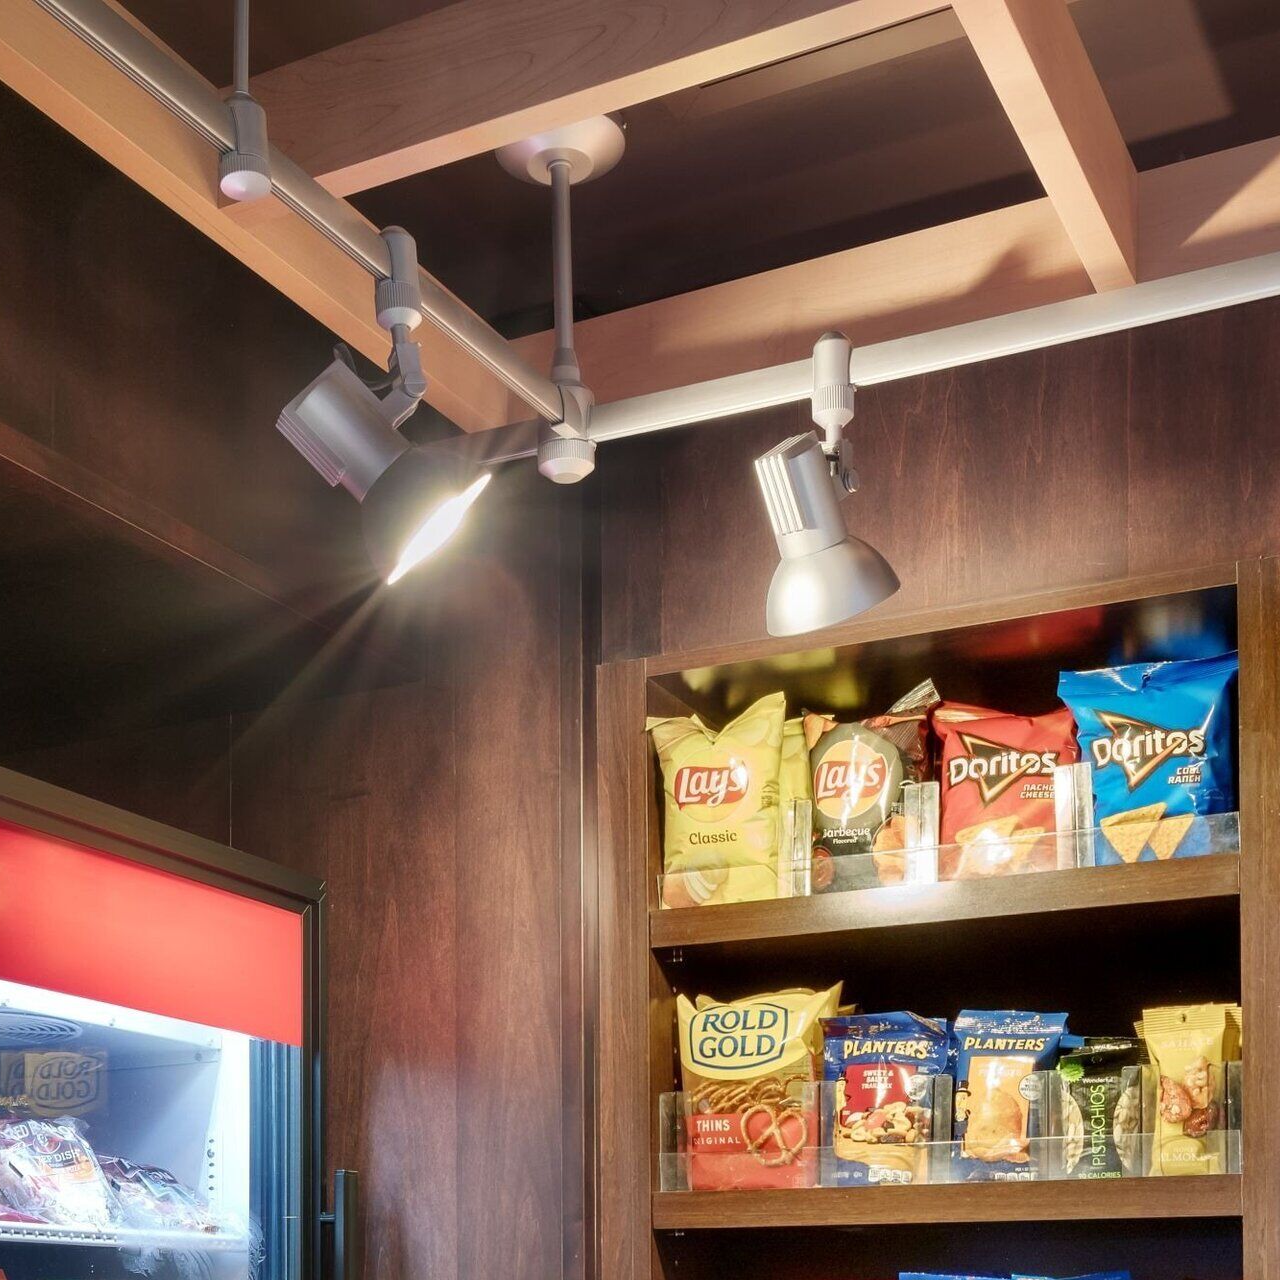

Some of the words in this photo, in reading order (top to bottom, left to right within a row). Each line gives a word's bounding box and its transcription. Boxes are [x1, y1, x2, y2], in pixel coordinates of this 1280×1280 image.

[1092, 729, 1207, 768] Doritos
[949, 752, 1058, 787] Doritos
[1168, 774, 1201, 784] RANCH
[689, 830, 737, 845] Classic
[701, 1010, 778, 1033] ROLD
[699, 1034, 776, 1058] GOLD
[844, 1040, 928, 1059] PLANTERS
[963, 1037, 1045, 1051] PLANTERS
[696, 1119, 730, 1131] THINS
[1090, 1085, 1107, 1166] PISTACHIOS
[1088, 1171, 1121, 1179] CALORIES
